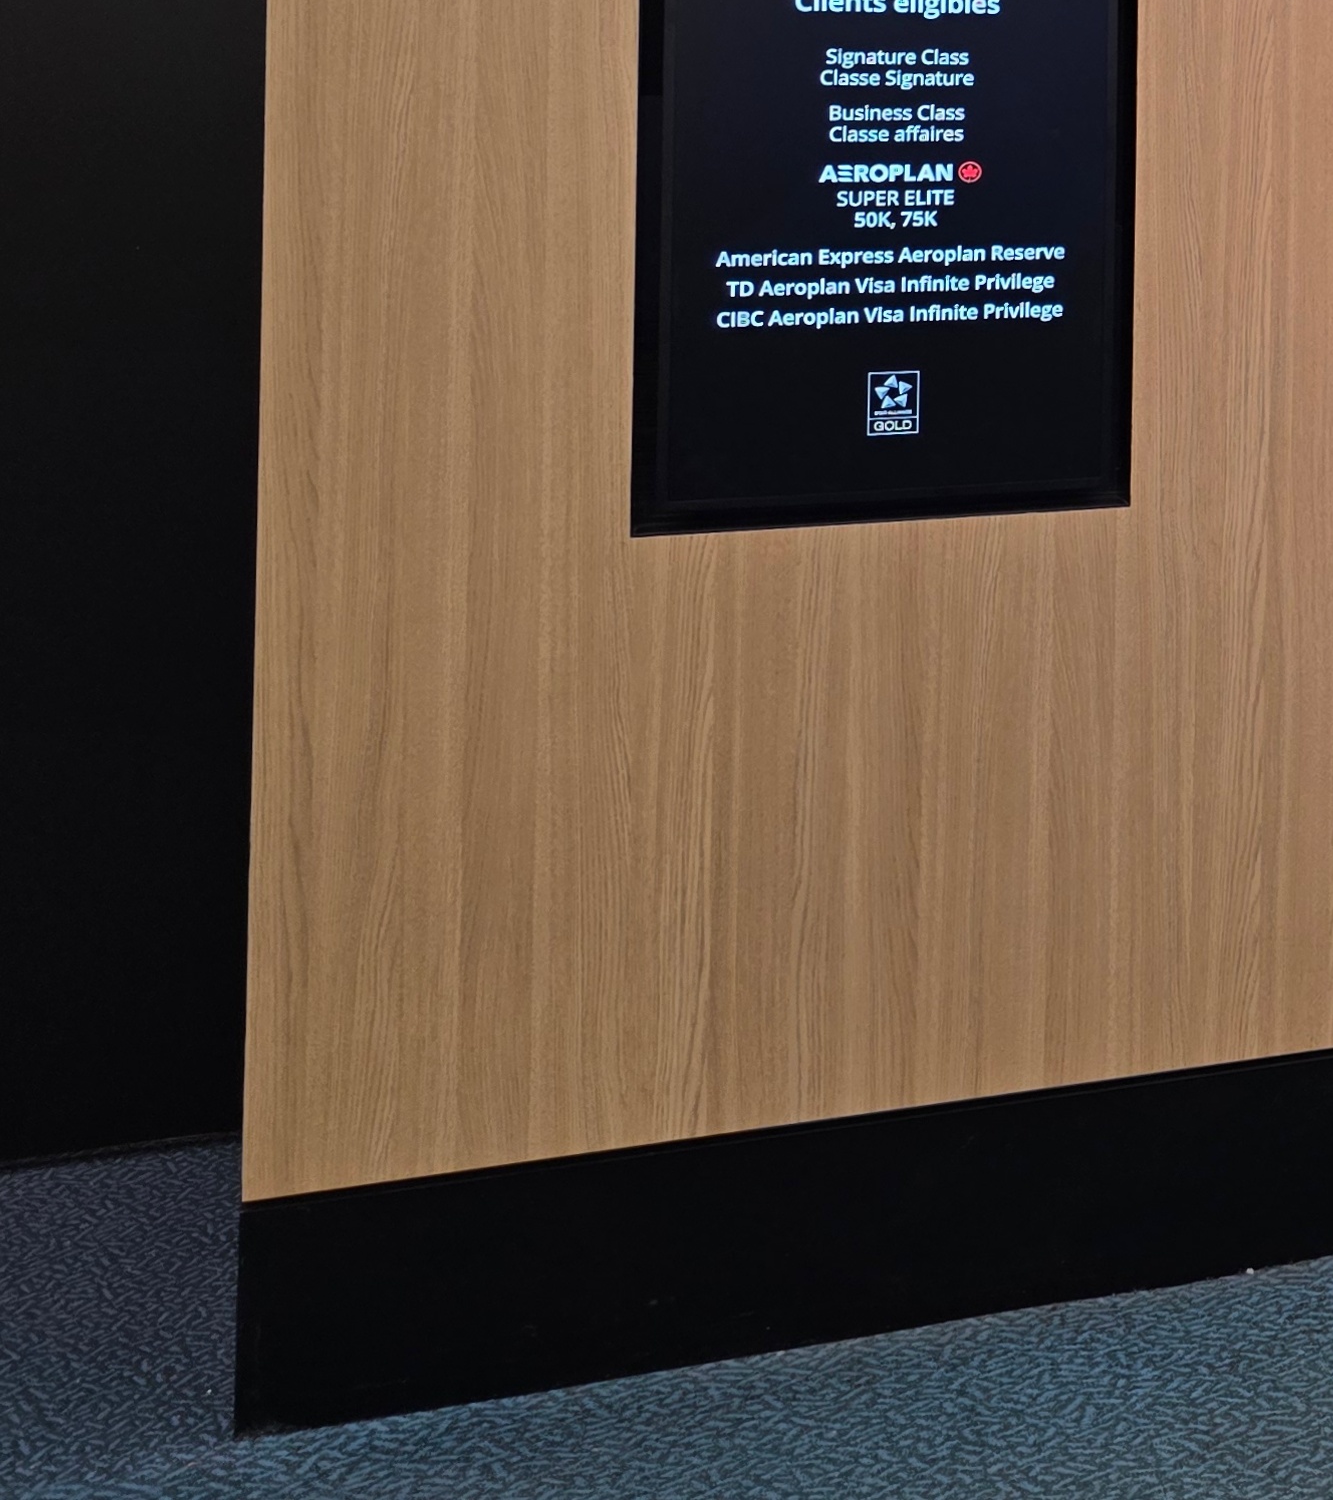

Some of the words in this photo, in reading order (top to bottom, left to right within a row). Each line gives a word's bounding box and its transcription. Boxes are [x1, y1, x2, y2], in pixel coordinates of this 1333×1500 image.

[825, 49, 917, 69] Signature
[921, 49, 970, 66] Class
[820, 70, 881, 88] Classe
[885, 70, 975, 90] Signature
[829, 105, 912, 122] Business
[917, 105, 966, 122] Class
[828, 126, 889, 143] Classe
[894, 125, 964, 143] affaires
[836, 190, 900, 208] SUPER
[904, 189, 955, 206] ELITE
[853, 211, 896, 230] 50K,
[900, 210, 938, 227] 75K
[716, 249, 813, 268] American
[818, 247, 894, 268] Express
[898, 245, 986, 267] Aeroplan
[991, 243, 1066, 262] Reserve
[726, 281, 754, 298] TD
[759, 278, 850, 300] Aeroplan
[855, 276, 895, 295] Visa
[901, 275, 970, 294] Infinite
[975, 272, 1055, 296] Privilege
[716, 310, 764, 328] CIBC
[768, 306, 859, 329] Aeroplan
[864, 305, 904, 324] Visa
[909, 303, 978, 322] Infinite
[984, 301, 1064, 325] Privilege
[873, 419, 912, 433] GOLD
